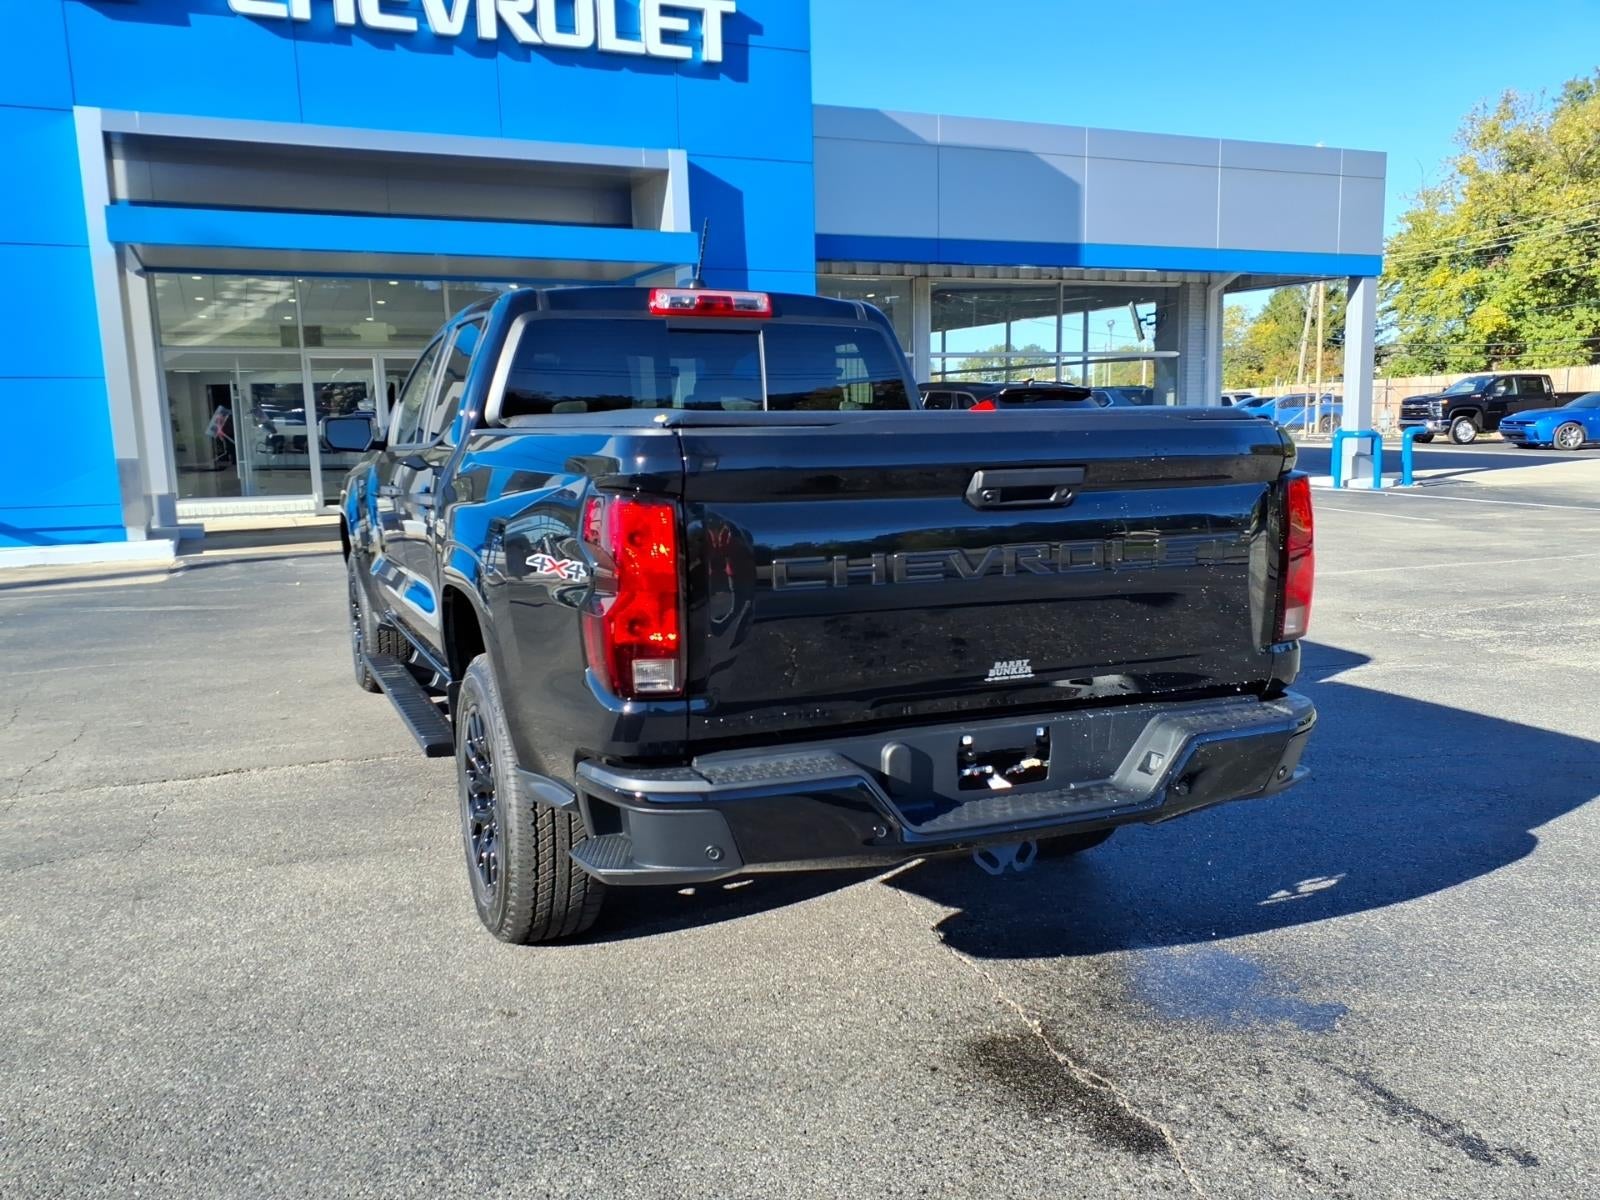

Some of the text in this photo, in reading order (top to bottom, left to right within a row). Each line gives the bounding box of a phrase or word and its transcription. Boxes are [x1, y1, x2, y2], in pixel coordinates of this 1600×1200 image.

[772, 532, 1240, 591] CHEVROLET
[994, 659, 1030, 669] BARRY
[989, 665, 1032, 677] BUNKER
